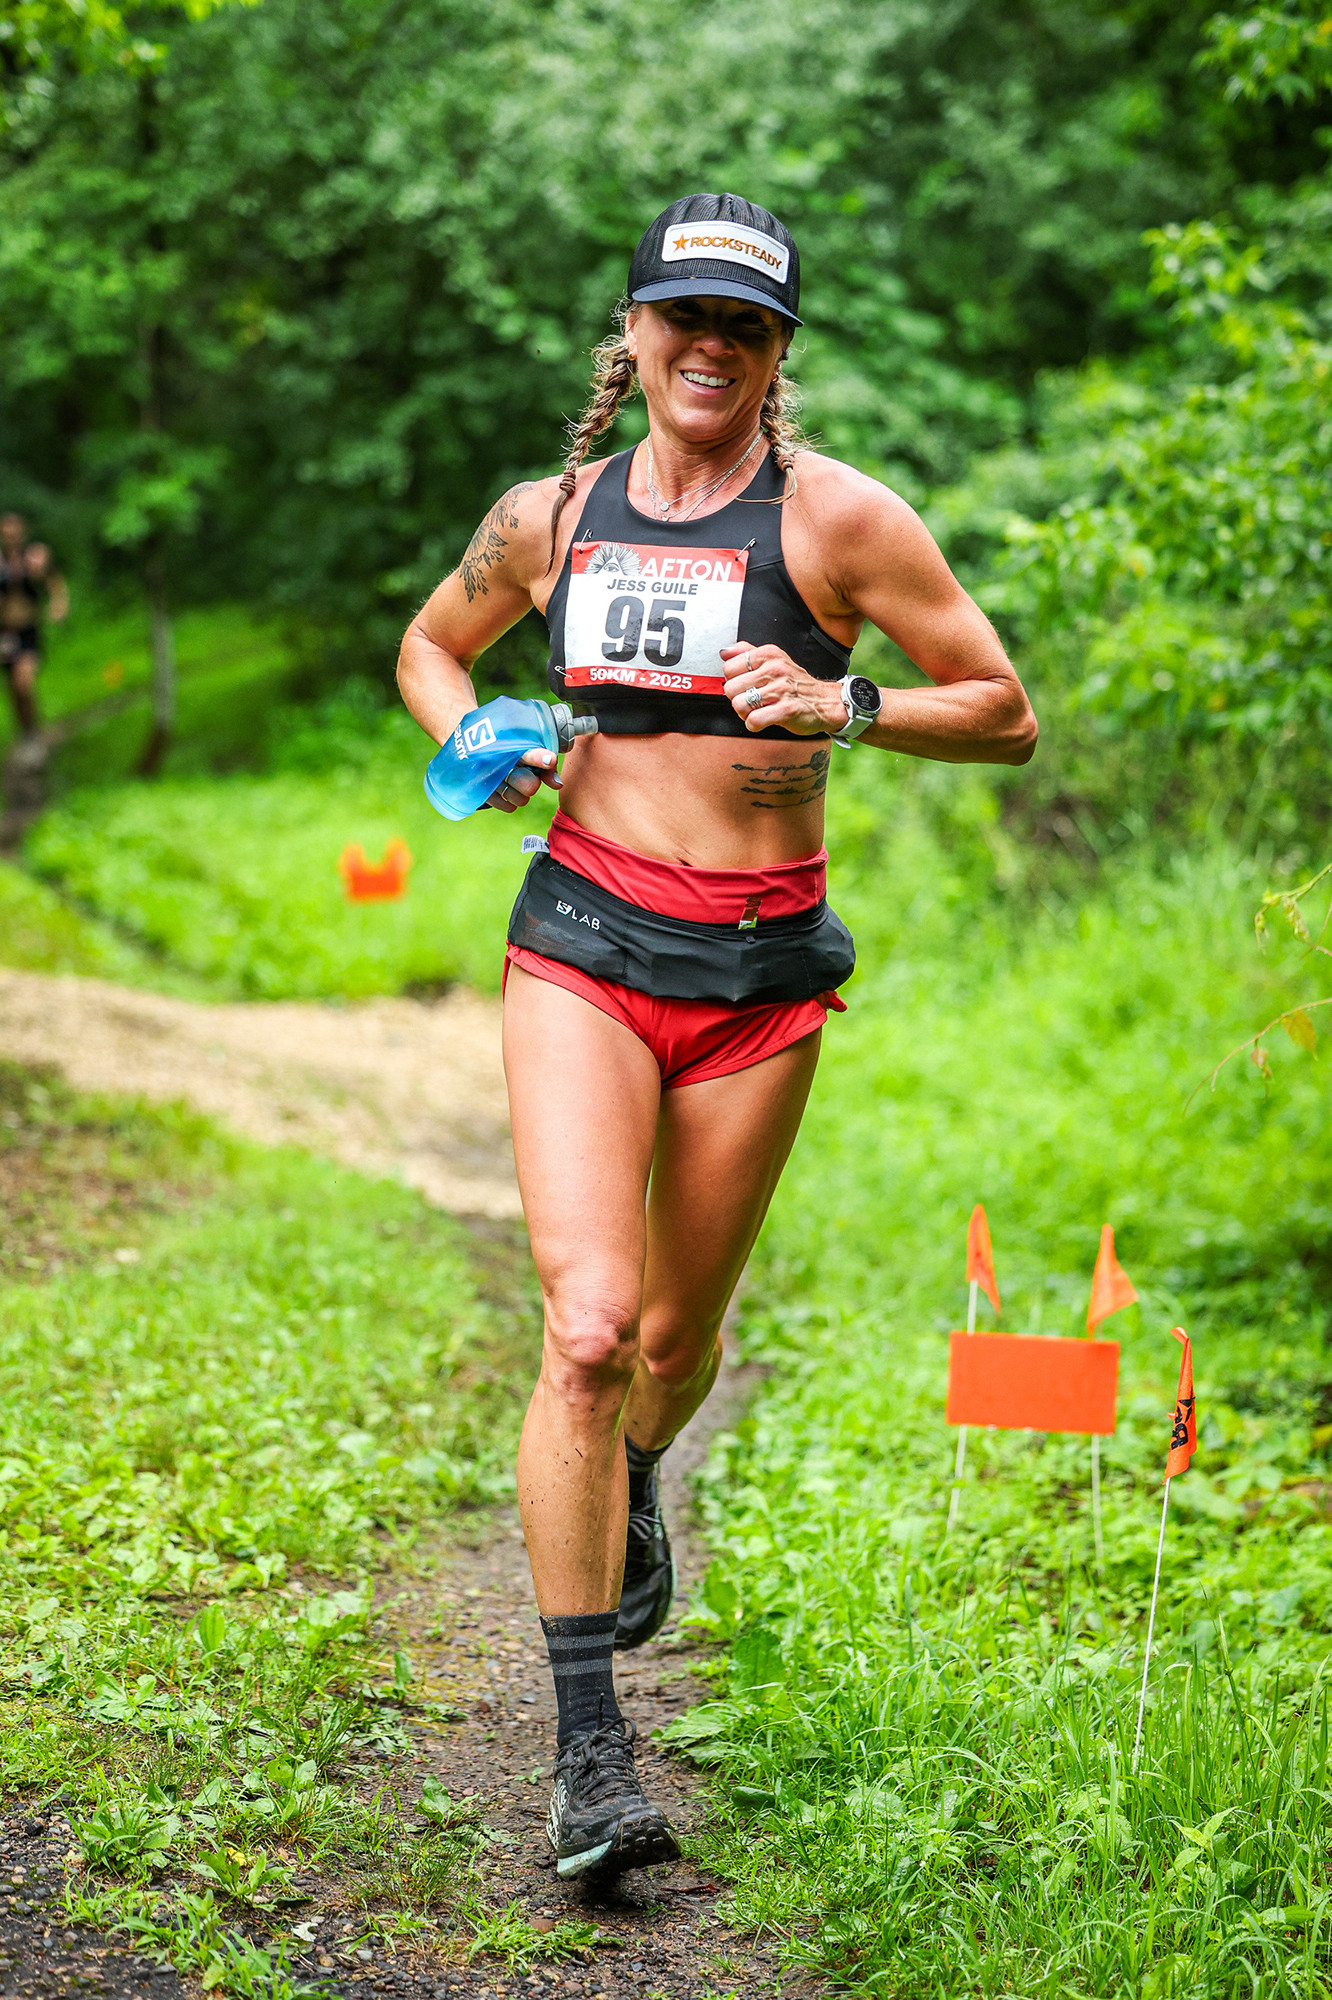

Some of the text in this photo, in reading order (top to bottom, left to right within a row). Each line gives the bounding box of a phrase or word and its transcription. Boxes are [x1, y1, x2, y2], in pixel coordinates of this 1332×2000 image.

[690, 236, 782, 269] ROCKSTEADY
[640, 557, 732, 582] AFTON
[607, 578, 698, 595] JESS GUILE
[601, 595, 687, 667] 95
[590, 668, 637, 683] 50KM
[649, 672, 692, 690] 2025
